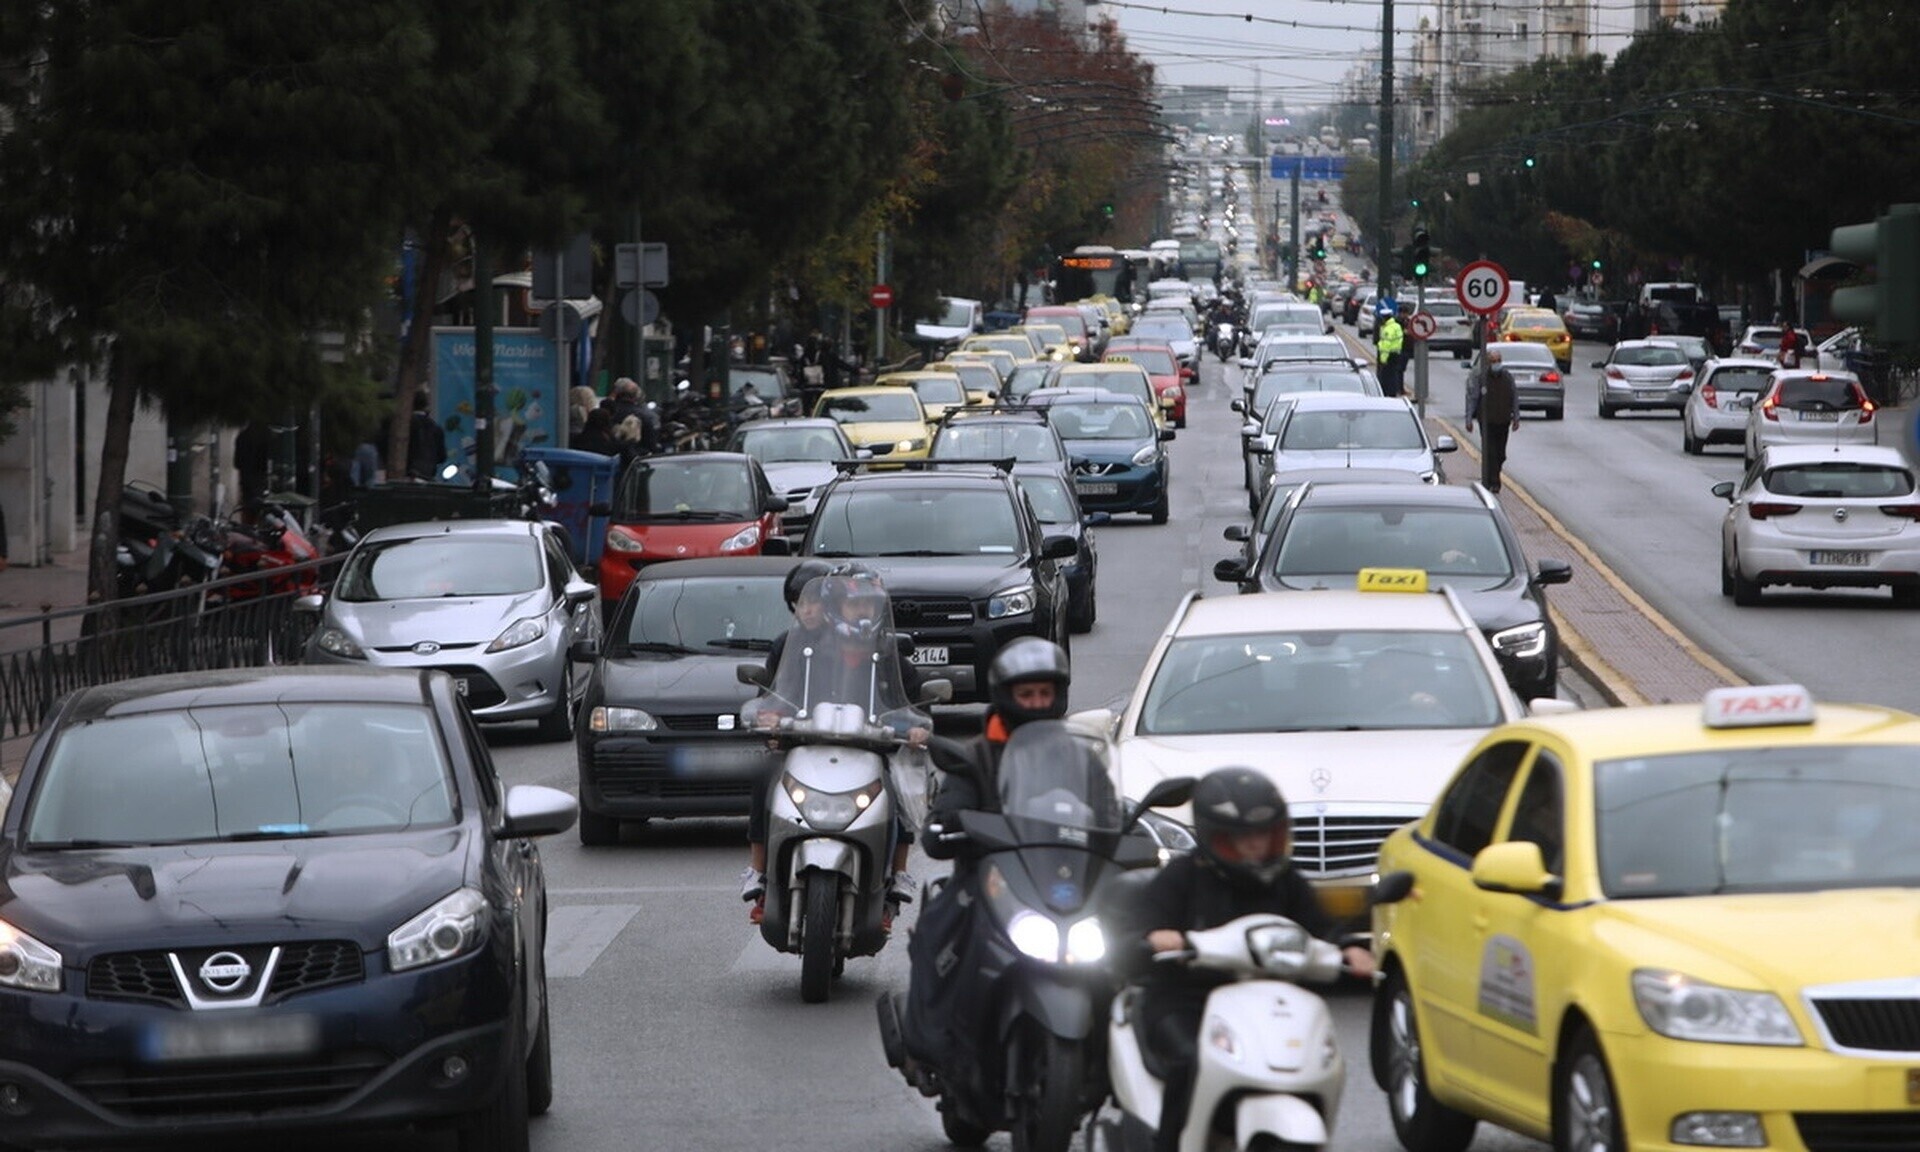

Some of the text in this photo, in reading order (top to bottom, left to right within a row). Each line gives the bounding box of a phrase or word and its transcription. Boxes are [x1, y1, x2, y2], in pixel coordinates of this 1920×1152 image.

[1468, 278, 1498, 297] 60
[1364, 573, 1419, 585] Taxi
[912, 649, 946, 662] 8144
[1719, 696, 1805, 715] TAXI
